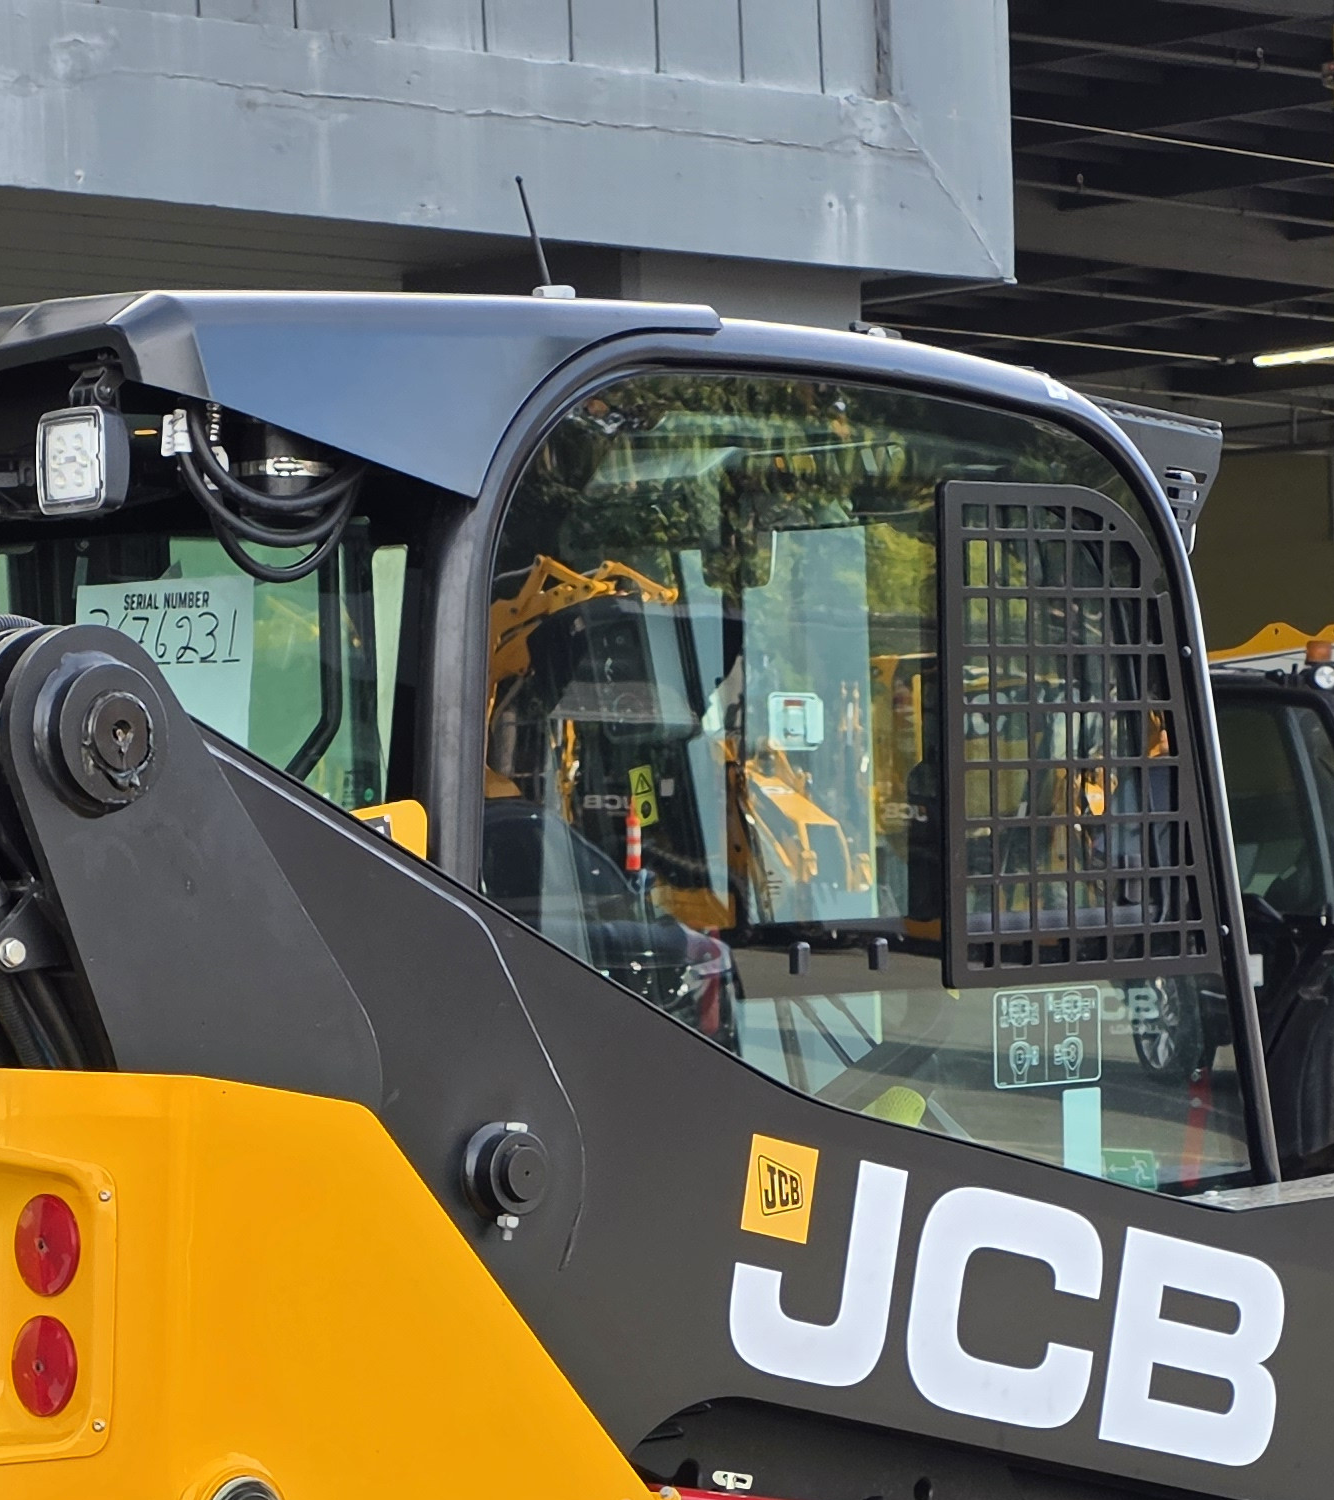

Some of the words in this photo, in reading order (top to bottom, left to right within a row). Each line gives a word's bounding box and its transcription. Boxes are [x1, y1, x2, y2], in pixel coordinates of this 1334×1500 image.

[124, 594, 159, 610] SERIAL
[164, 591, 210, 609] NUMBER
[1101, 987, 1160, 1020] CB
[764, 1163, 800, 1209] JCB
[730, 1160, 1285, 1467] JCB
